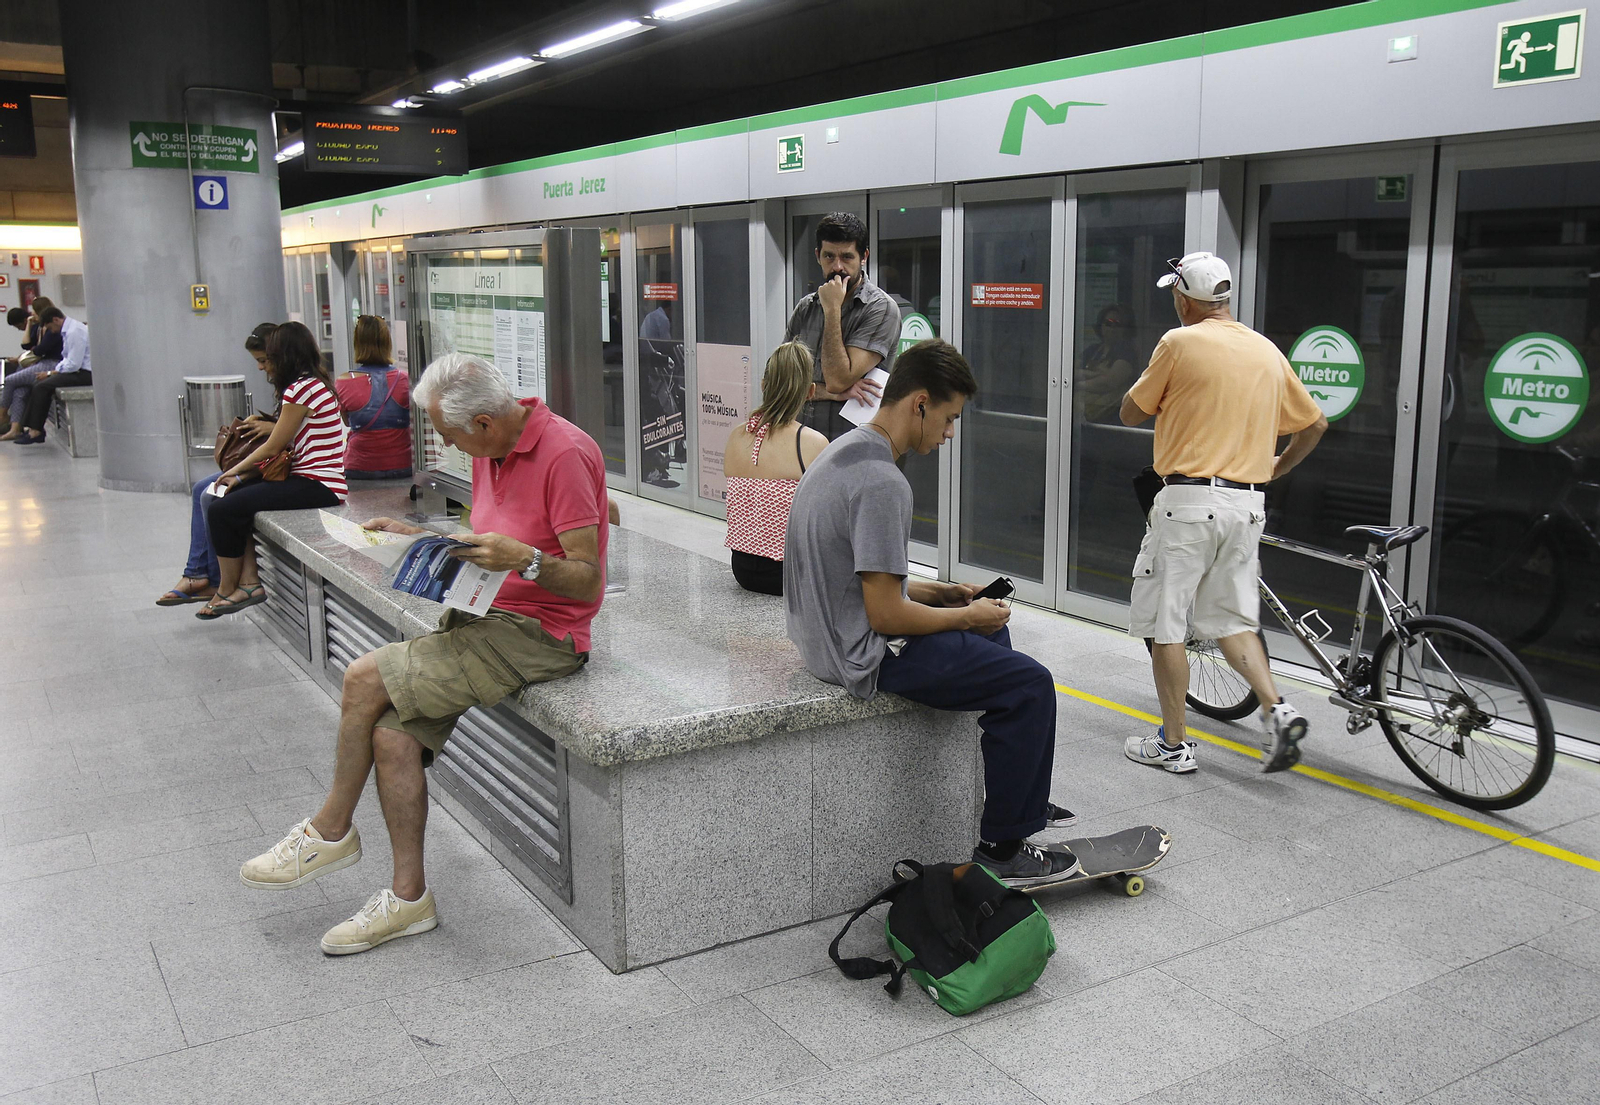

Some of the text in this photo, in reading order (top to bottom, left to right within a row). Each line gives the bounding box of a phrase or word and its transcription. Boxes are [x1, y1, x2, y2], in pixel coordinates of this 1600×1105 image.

[151, 132, 244, 146] NO SE DETENGAN
[210, 145, 237, 153] OCUPEN
[543, 176, 606, 199] Puerta Jerez
[474, 271, 502, 289] Línea 1
[1299, 365, 1350, 383] Metro
[1502, 377, 1570, 399] Metro
[702, 404, 716, 415] 100%
[717, 403, 739, 418] MÚSICA
[656, 414, 667, 427] SIN
[643, 420, 684, 444] EDULCORANTES
